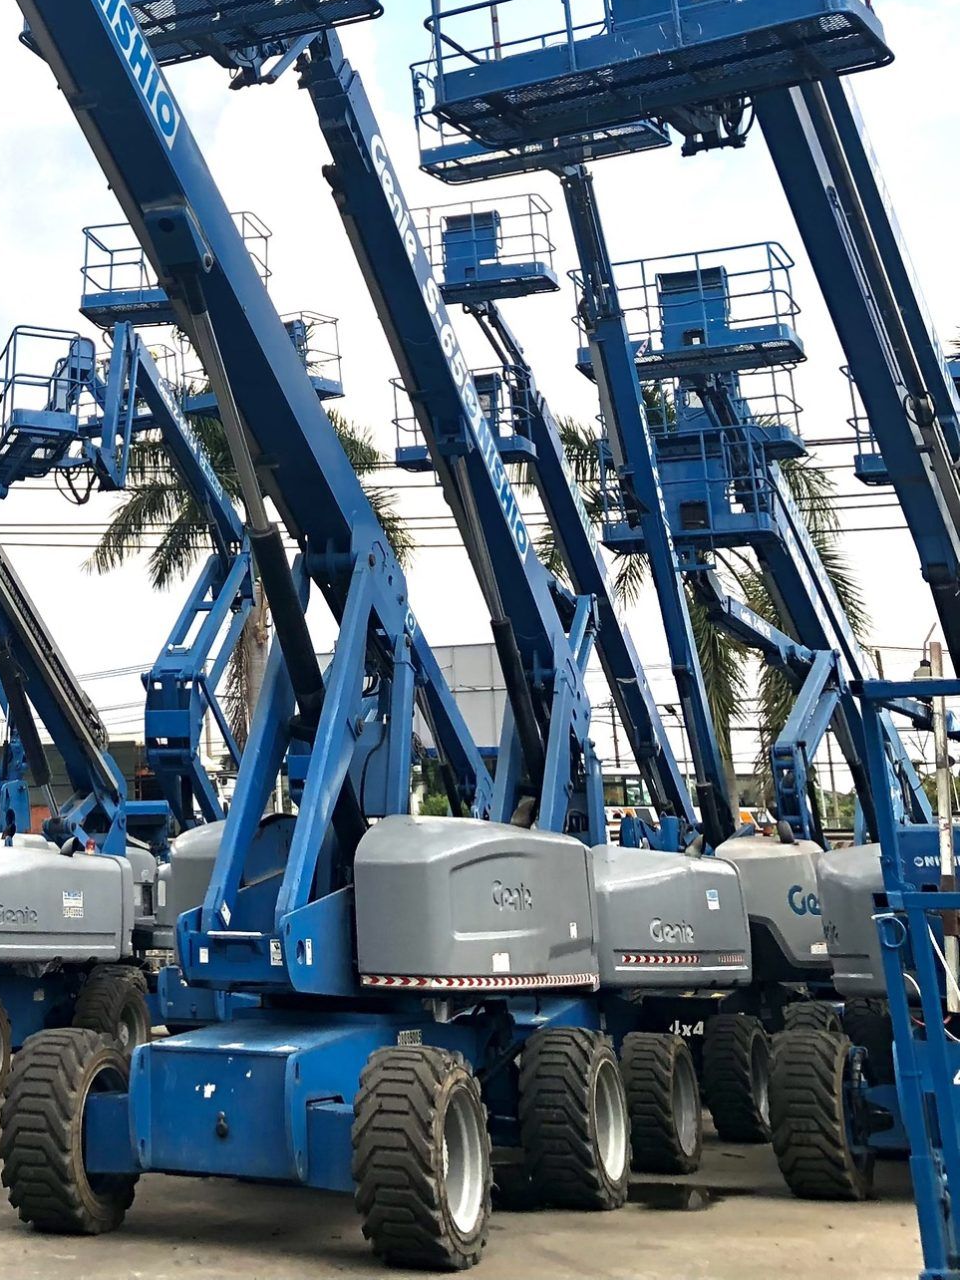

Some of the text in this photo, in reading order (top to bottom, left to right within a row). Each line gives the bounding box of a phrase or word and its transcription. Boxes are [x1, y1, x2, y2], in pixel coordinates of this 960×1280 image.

[370, 134, 527, 554] Genie S-65 NISHIO
[492, 879, 533, 912] Genie
[649, 917, 695, 944] Genie
